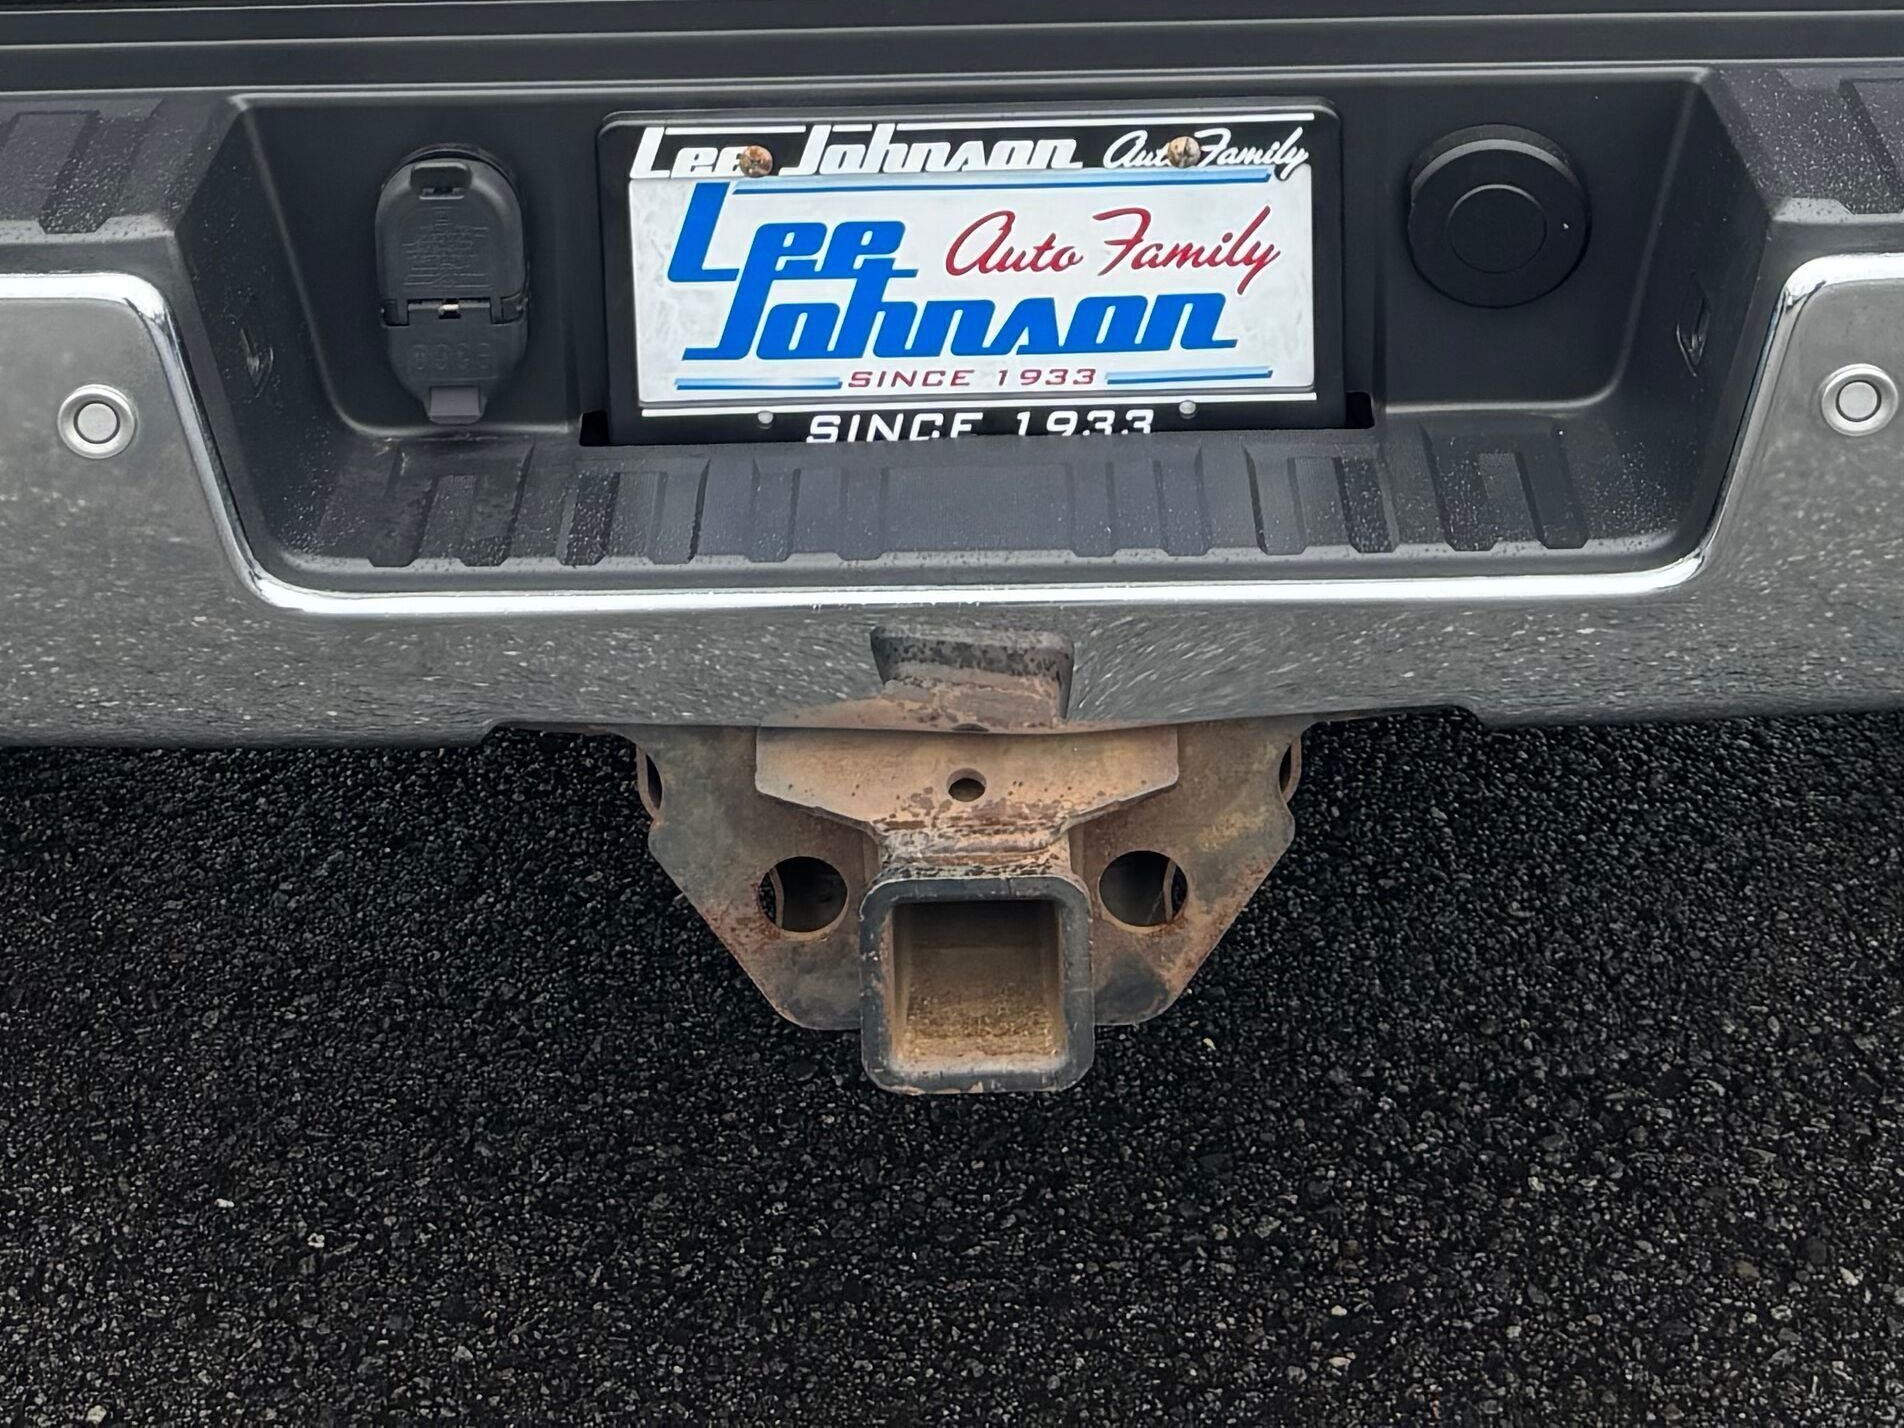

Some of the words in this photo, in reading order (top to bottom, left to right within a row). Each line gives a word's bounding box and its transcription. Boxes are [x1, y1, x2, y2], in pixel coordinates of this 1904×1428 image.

[778, 124, 1084, 176] Johnson
[1103, 129, 1179, 170] Aut
[1193, 126, 1310, 181] Family
[667, 182, 918, 283] Lee
[945, 209, 1084, 277] Auto
[1092, 205, 1282, 296] Family
[682, 256, 1239, 361] Johnson
[848, 368, 972, 389] SINCE
[995, 366, 1097, 387] 1933
[805, 411, 984, 443] SINCE
[1017, 408, 1155, 437] 1933
